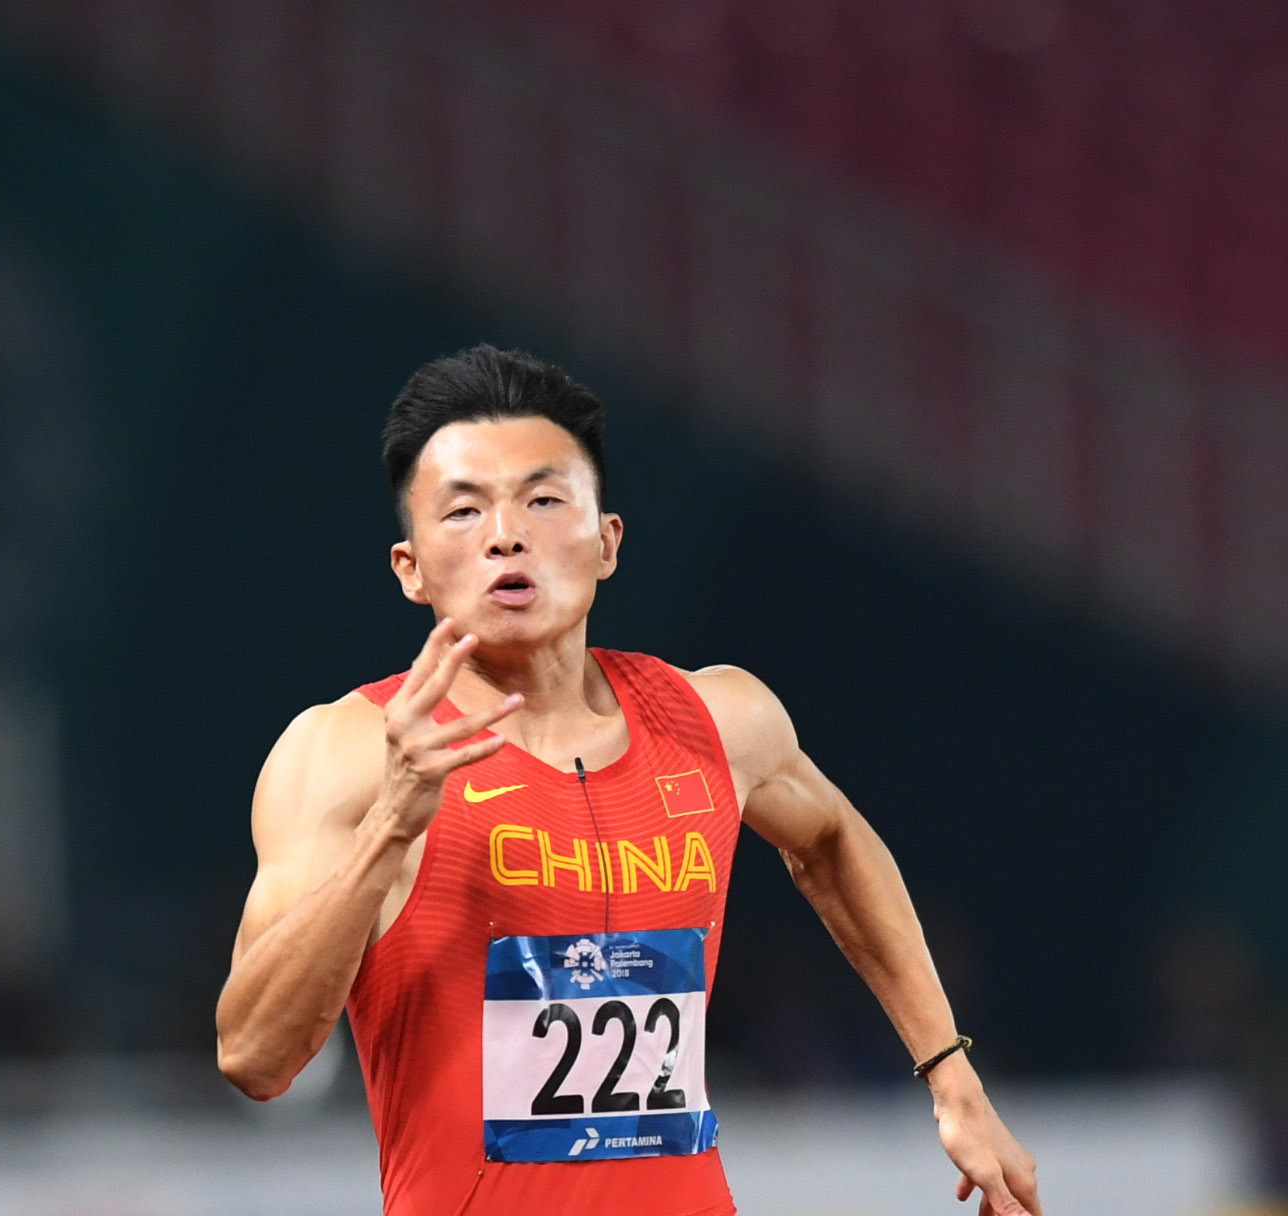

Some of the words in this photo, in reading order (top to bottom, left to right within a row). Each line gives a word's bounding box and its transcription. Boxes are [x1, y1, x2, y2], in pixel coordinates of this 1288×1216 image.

[488, 823, 717, 894] CHINA
[530, 997, 687, 1116] 222
[604, 1135, 663, 1149] PERTAMINA
